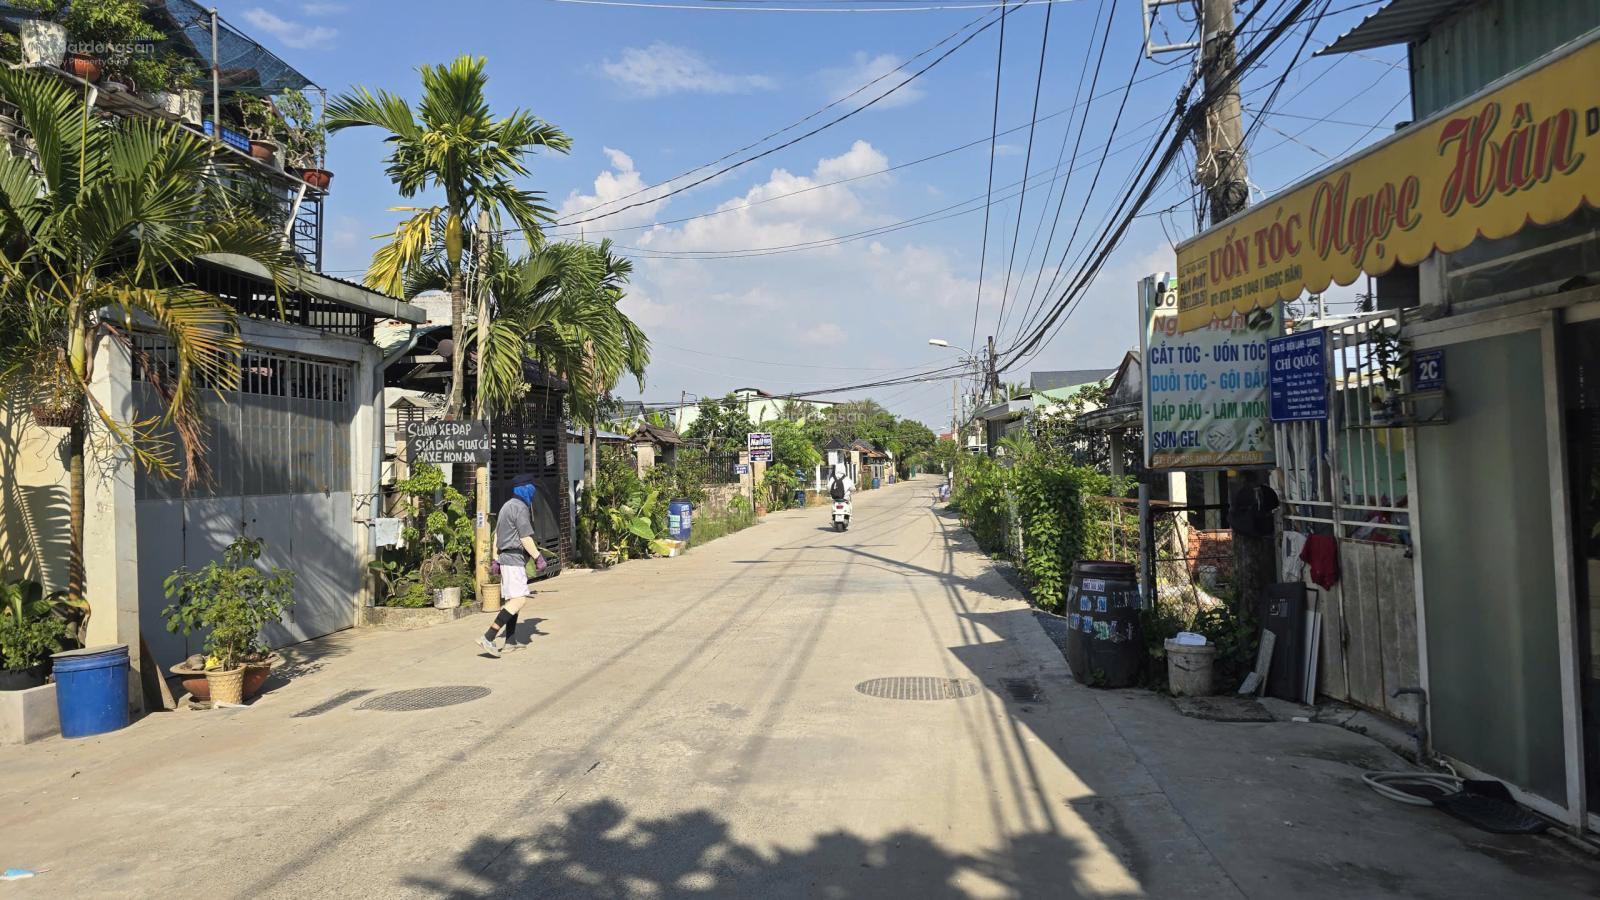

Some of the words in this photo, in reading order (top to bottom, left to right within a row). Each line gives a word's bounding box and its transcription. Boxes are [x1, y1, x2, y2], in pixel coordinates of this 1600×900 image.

[1210, 226, 1250, 286] UỐN
[1254, 206, 1302, 269] TÓC
[1308, 172, 1422, 269] Ngọc
[1440, 101, 1586, 217] Hân
[1151, 341, 1174, 364] CẮT
[1178, 342, 1201, 364] TÓC
[1213, 338, 1239, 362] UỐN
[1242, 340, 1267, 361] TÓC
[1275, 354, 1291, 371] CHÍ
[1292, 348, 1320, 370] QUỐC
[1184, 370, 1207, 390] TÓC
[1220, 368, 1240, 393] GỘI
[1419, 360, 1438, 380] 2C
[1152, 398, 1175, 421] HẤP
[1213, 399, 1238, 420] LÀM
[1153, 429, 1177, 448] SƠN
[1180, 430, 1200, 447] GEL
